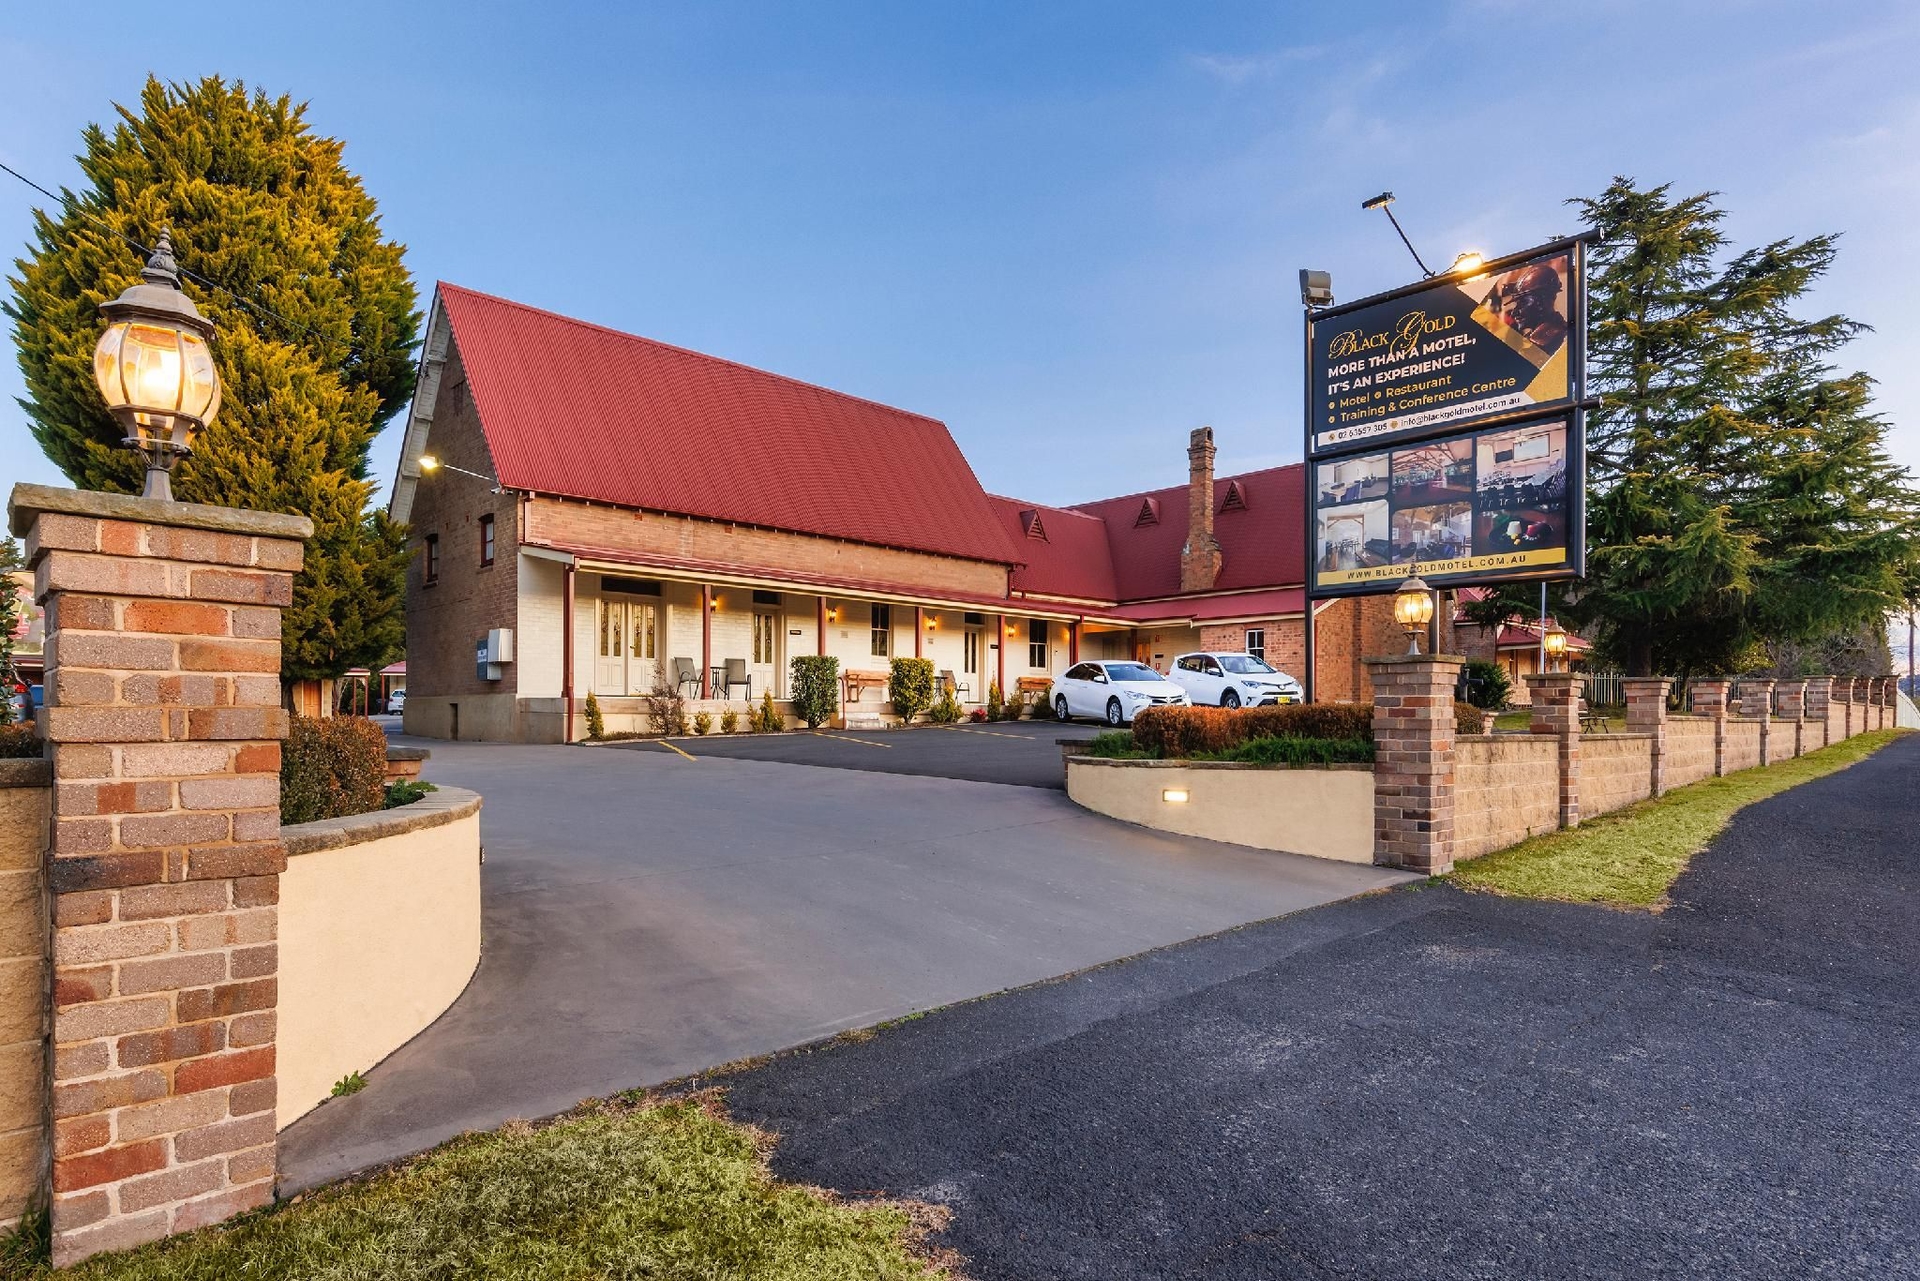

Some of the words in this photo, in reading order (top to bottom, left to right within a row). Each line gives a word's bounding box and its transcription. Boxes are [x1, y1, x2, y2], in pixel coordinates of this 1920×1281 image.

[1328, 359, 1366, 378] MORE
[1368, 351, 1406, 368] THAN
[1408, 347, 1420, 359] A
[1422, 333, 1477, 355] MOTEL,
[1328, 380, 1350, 395] IT'S
[1352, 375, 1372, 389] AN
[1375, 352, 1466, 384] EXPERIENCE!
[1340, 392, 1370, 408] Motel
[1386, 375, 1452, 398] Restaurant
[1340, 405, 1386, 422] Training
[1388, 402, 1397, 412] &
[1398, 388, 1469, 410] Conference
[1471, 377, 1516, 394] Centre
[1401, 397, 1520, 426] info@blackgoldmotel.com.au
[1347, 554, 1526, 579] WWW.BLACKOLDMOTEL.COM.AU
